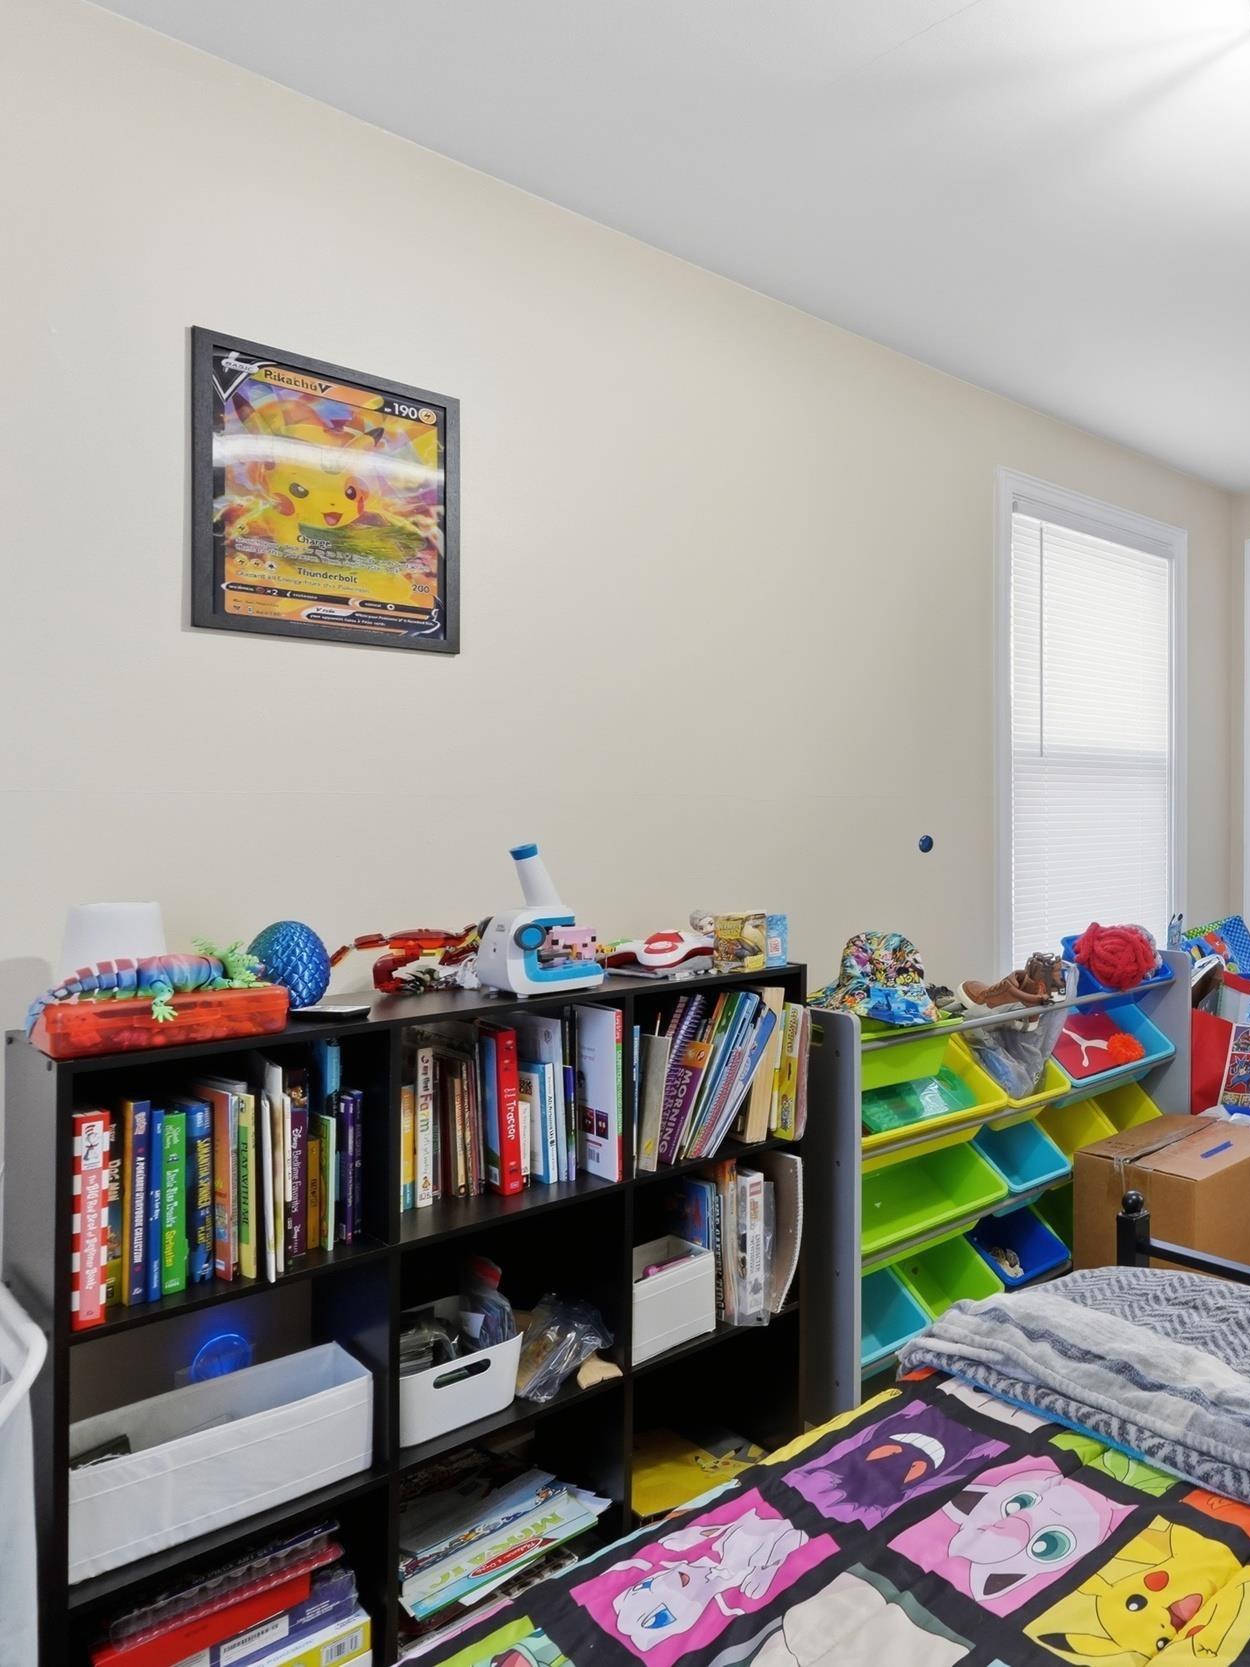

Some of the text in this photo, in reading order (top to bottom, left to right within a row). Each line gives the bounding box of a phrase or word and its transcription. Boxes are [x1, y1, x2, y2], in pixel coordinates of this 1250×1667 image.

[393, 402, 418, 419] 190
[297, 567, 358, 584] Thunderbolt
[505, 1100, 517, 1141] Tractor
[659, 1069, 693, 1154] MORNING
[291, 1125, 303, 1149] Disney
[107, 1159, 121, 1202] DOG MAN
[196, 1137, 212, 1209] SAMANTHA SPINNER
[291, 1149, 302, 1180] Bedtime
[86, 1184, 100, 1199] BIG
[133, 1227, 144, 1263] COLLECTION
